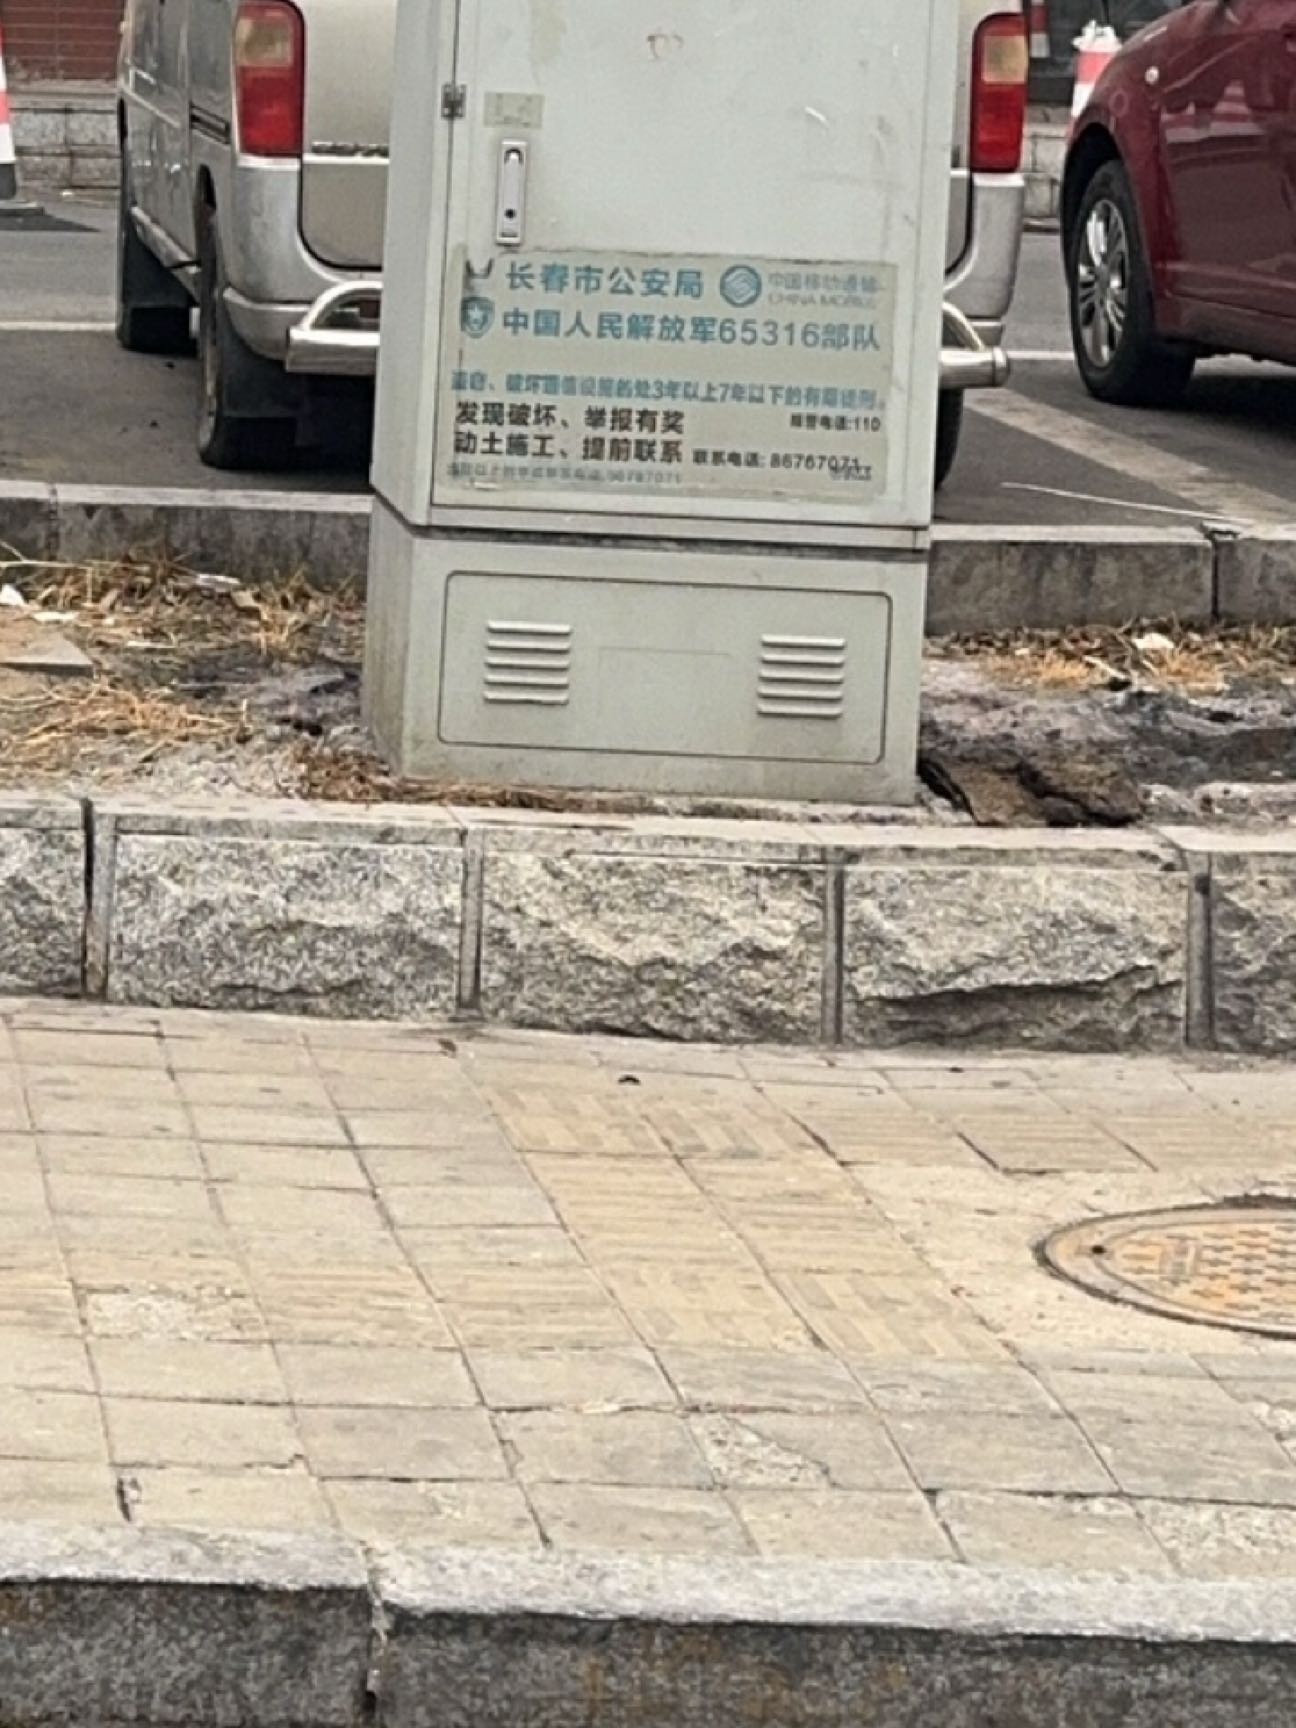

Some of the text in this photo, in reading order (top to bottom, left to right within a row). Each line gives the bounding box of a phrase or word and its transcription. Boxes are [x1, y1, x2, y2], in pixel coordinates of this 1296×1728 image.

[506, 260, 704, 299] 长春市公安局
[502, 308, 882, 353] 中国人民解放军65316部队
